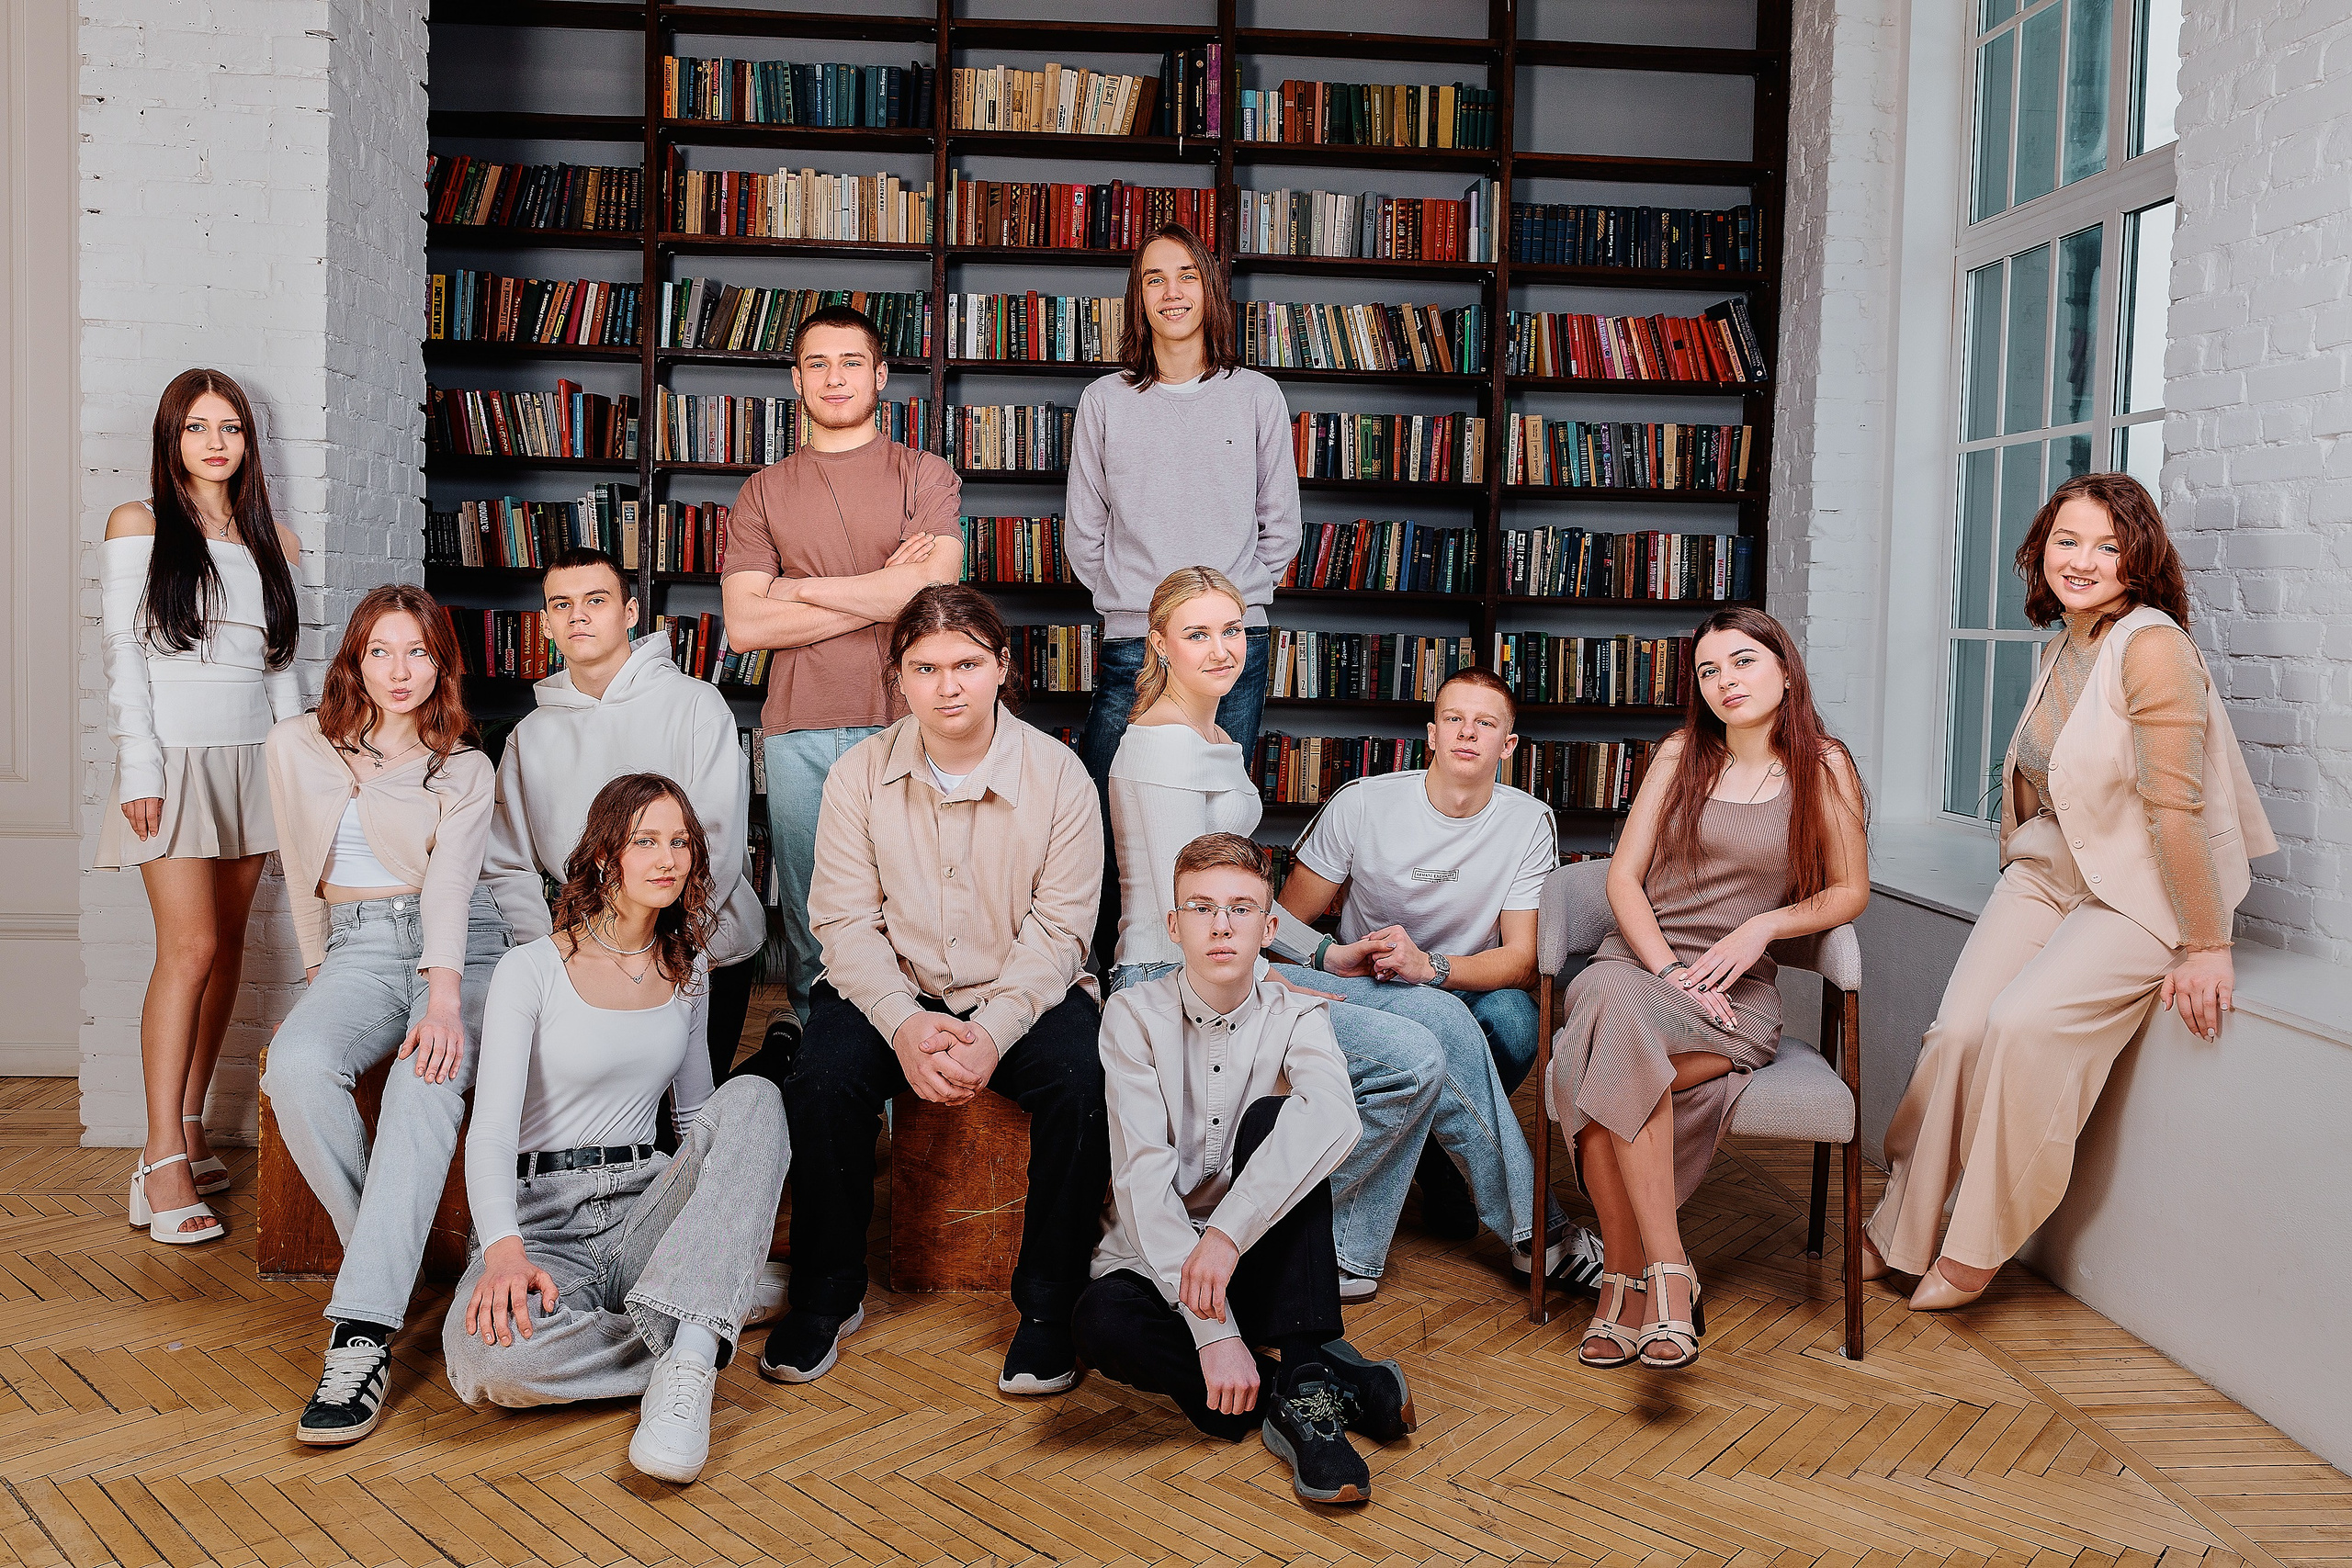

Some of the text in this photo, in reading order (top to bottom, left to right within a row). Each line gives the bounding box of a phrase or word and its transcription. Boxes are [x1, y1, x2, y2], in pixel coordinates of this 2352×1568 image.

[433, 286, 443, 334] ДЕТЕКТИВ
[537, 503, 544, 514] 1
[1515, 560, 1524, 581] Банда
[1649, 560, 1657, 592] ЗАЛОЖНИК
[1300, 680, 1306, 691] 2
